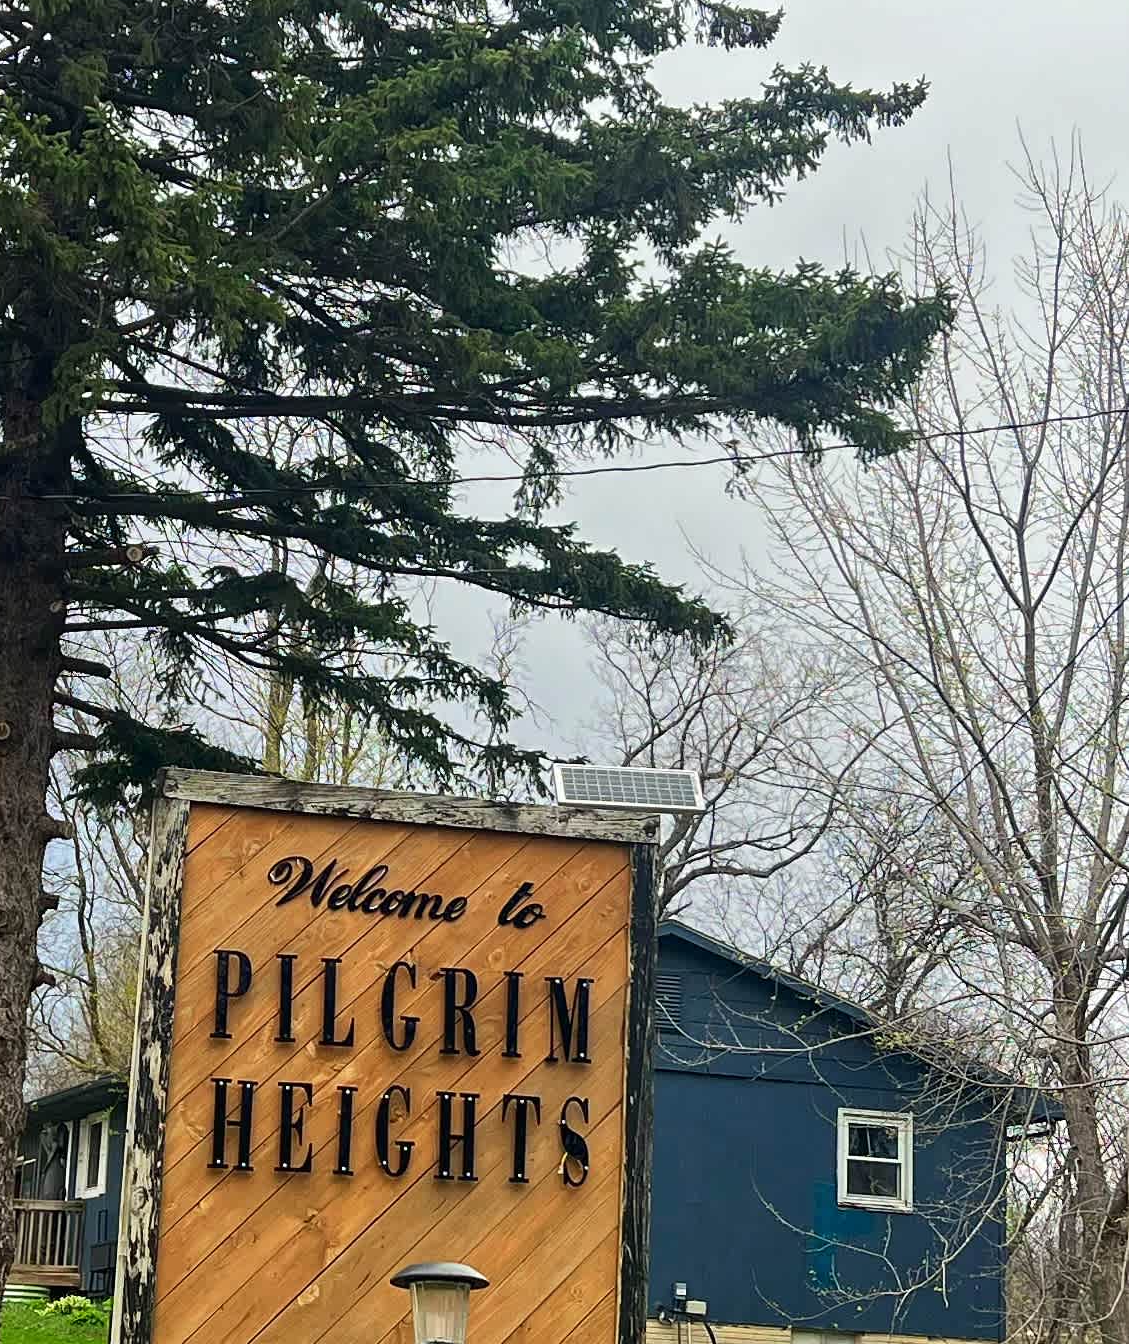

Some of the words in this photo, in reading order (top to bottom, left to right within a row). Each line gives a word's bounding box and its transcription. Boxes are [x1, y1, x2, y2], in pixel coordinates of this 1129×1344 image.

[267, 855, 468, 924] Welcome
[497, 881, 547, 930] to
[209, 948, 595, 1065] PILGRIM
[206, 1077, 590, 1188] HEIGHTS
